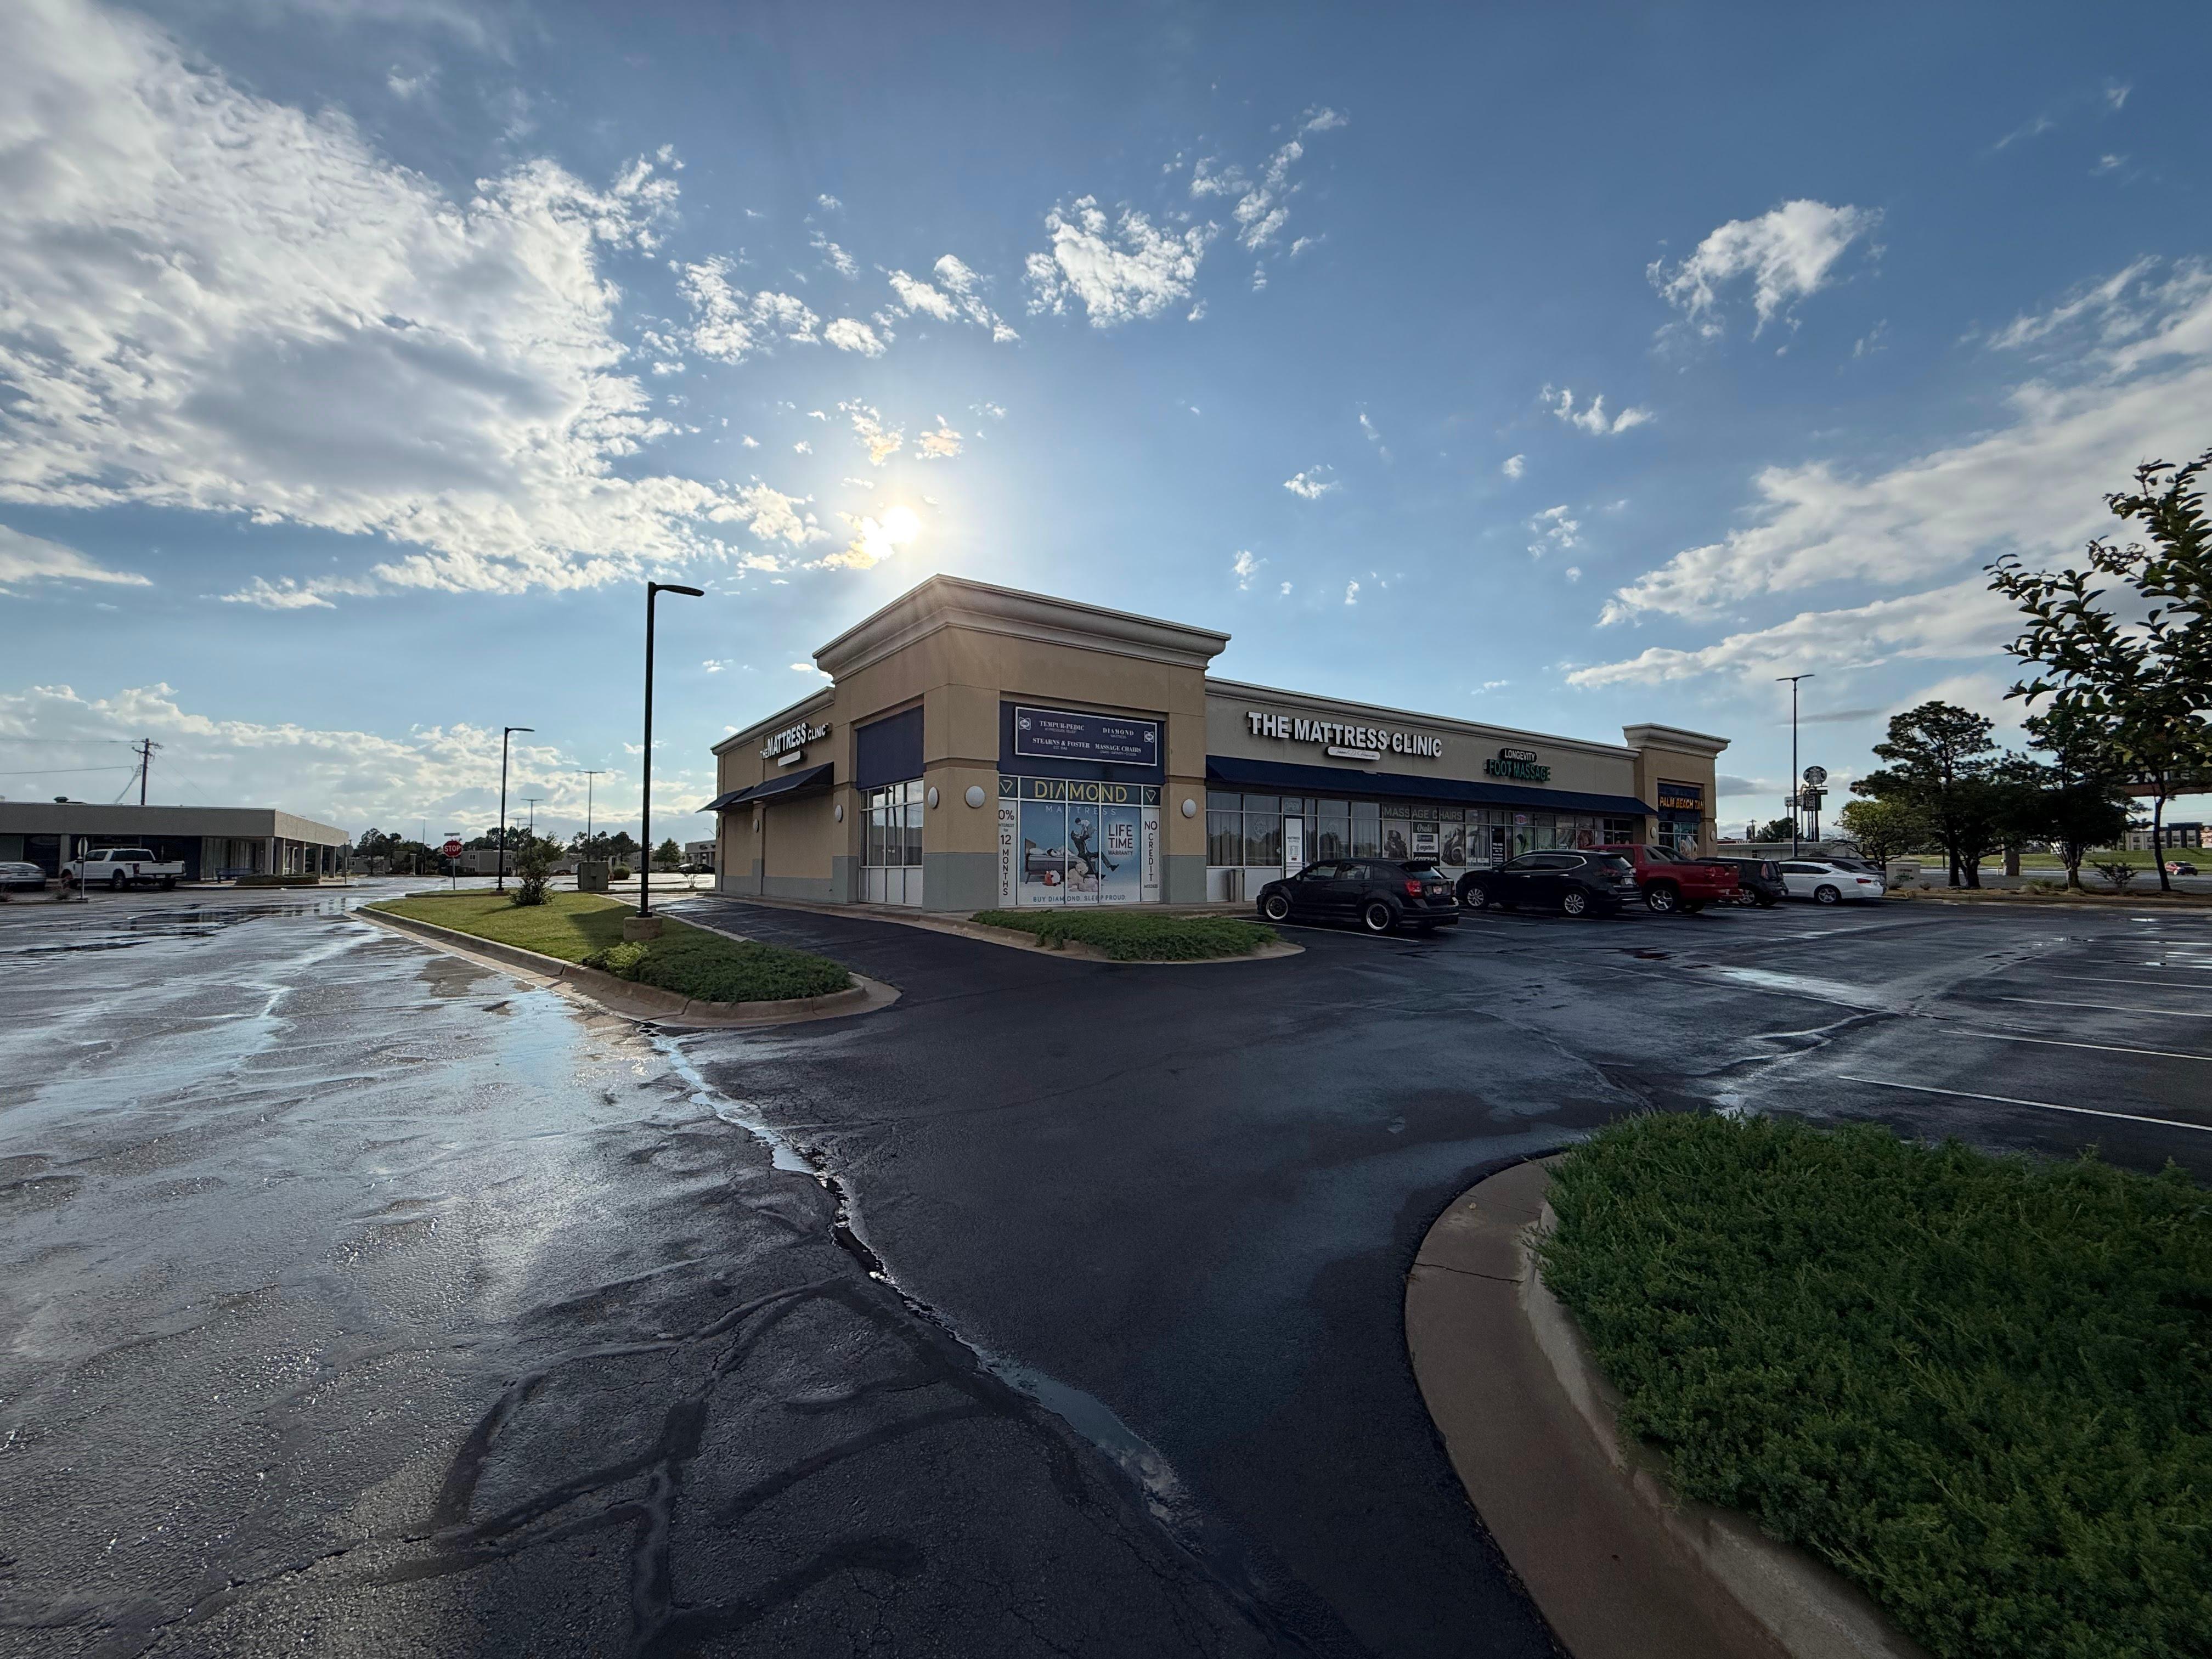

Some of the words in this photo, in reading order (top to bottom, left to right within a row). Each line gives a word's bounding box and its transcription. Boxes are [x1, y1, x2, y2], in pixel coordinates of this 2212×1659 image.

[1039, 720, 1085, 731] TEMPUR-PEDIC
[1103, 727, 1134, 736] DIAMOND
[1248, 712, 1289, 738] THE
[1295, 718, 1387, 750] MATTRESS
[1393, 732, 1442, 757] CLINIC
[760, 748, 768, 759] THE
[768, 723, 806, 758] MATTRESS
[808, 723, 828, 741] CLINIC
[1504, 749, 1536, 761] LONGEVITY
[1489, 759, 1512, 776] FOOT
[1514, 762, 1551, 781] MASSAGE
[1035, 780, 1127, 803] DIAMOND
[1660, 797, 1674, 808] PALM
[1676, 798, 1694, 809] BEACH
[998, 809, 1014, 821] 0%
[1046, 805, 1116, 816] MATTRESS
[1384, 807, 1429, 819] MASSAGE
[1432, 810, 1463, 820] CHAIRS
[1108, 824, 1133, 837] LIFE
[1144, 821, 1158, 830] NO
[1000, 834, 1011, 845] 12
[1108, 837, 1133, 849] TIME
